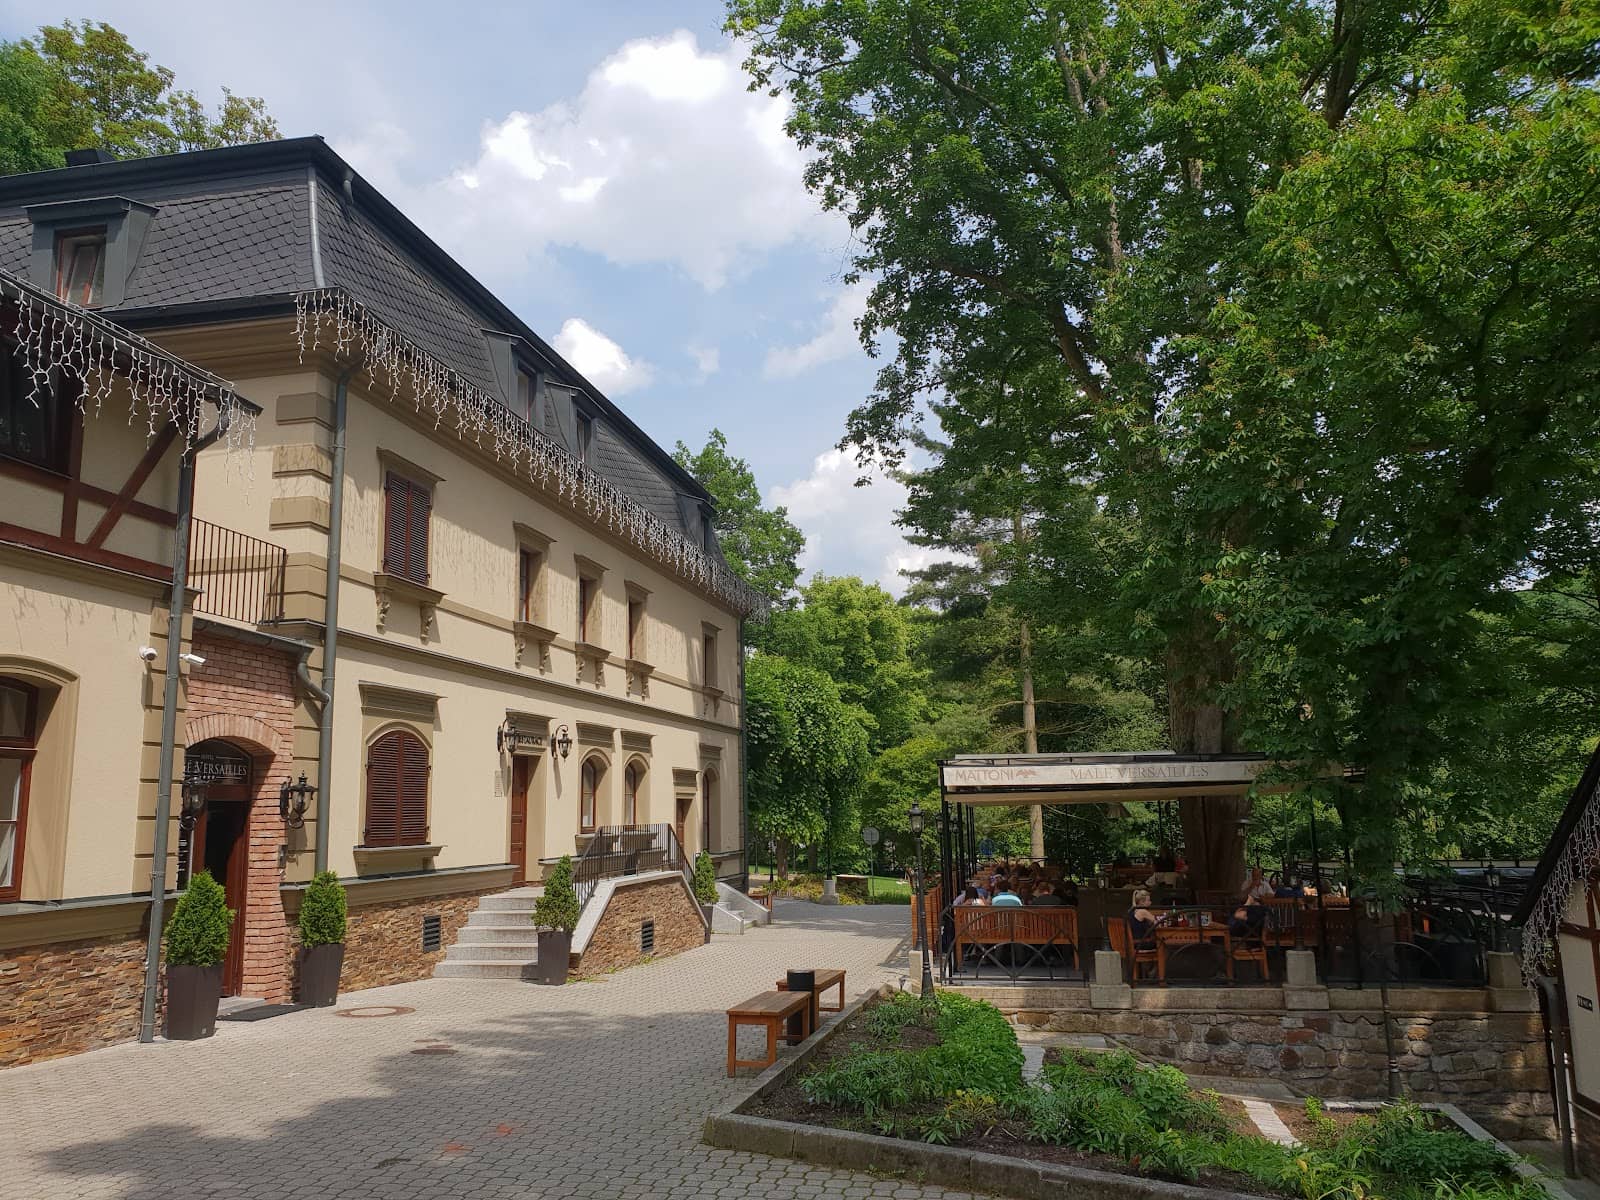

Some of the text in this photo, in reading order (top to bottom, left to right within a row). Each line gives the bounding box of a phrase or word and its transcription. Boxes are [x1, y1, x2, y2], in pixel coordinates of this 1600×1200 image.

[193, 761, 247, 776] VERSAILLES
[955, 769, 1014, 781] MATTONI
[1118, 766, 1209, 779] VERSAILLES
